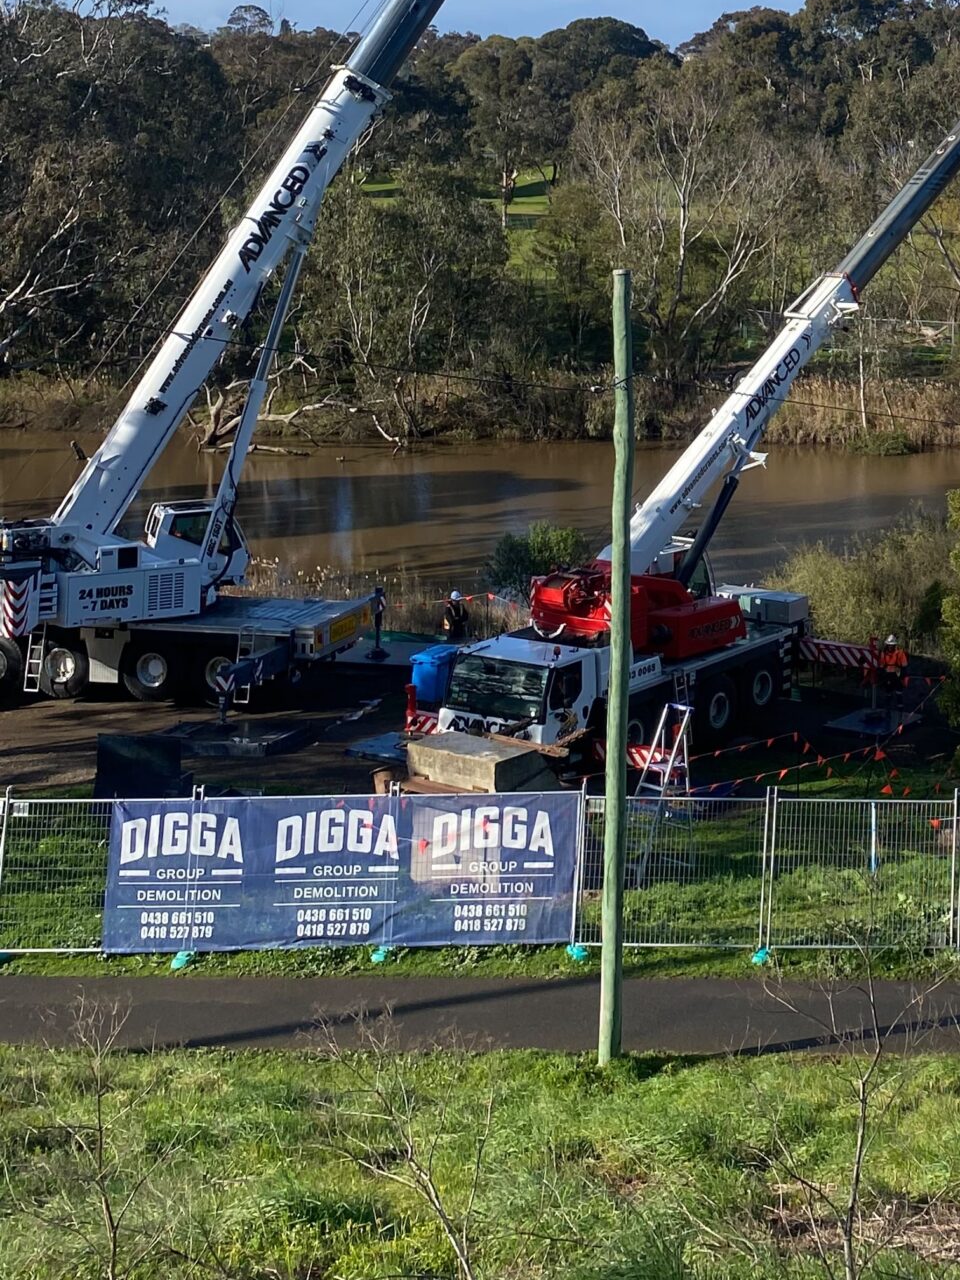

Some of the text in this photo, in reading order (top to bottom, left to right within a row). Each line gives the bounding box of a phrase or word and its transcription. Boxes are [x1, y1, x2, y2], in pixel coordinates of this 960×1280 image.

[238, 165, 310, 274] ADVANCED
[745, 348, 800, 428] ADVANCED
[79, 585, 134, 600] 24 HOURS
[100, 598, 129, 610] DAYS
[120, 812, 243, 865] DIGGA
[275, 809, 399, 863] DIGGA
[432, 806, 554, 859] DIGGA
[156, 868, 205, 879] GROUP
[313, 865, 362, 876] GROUP
[469, 861, 518, 872] GROUP
[137, 889, 221, 901] DEMOLITION
[293, 886, 378, 898] DEMOLITION
[450, 882, 534, 895] DEMOLITION
[141, 911, 214, 924] 0438 661 510
[297, 908, 372, 922] 0438 661 510
[454, 904, 527, 918] 0438 661 510
[296, 923, 370, 937] 0418 527 879
[454, 918, 526, 932] 0418 527 879
[140, 926, 213, 939] 0418 527 879
